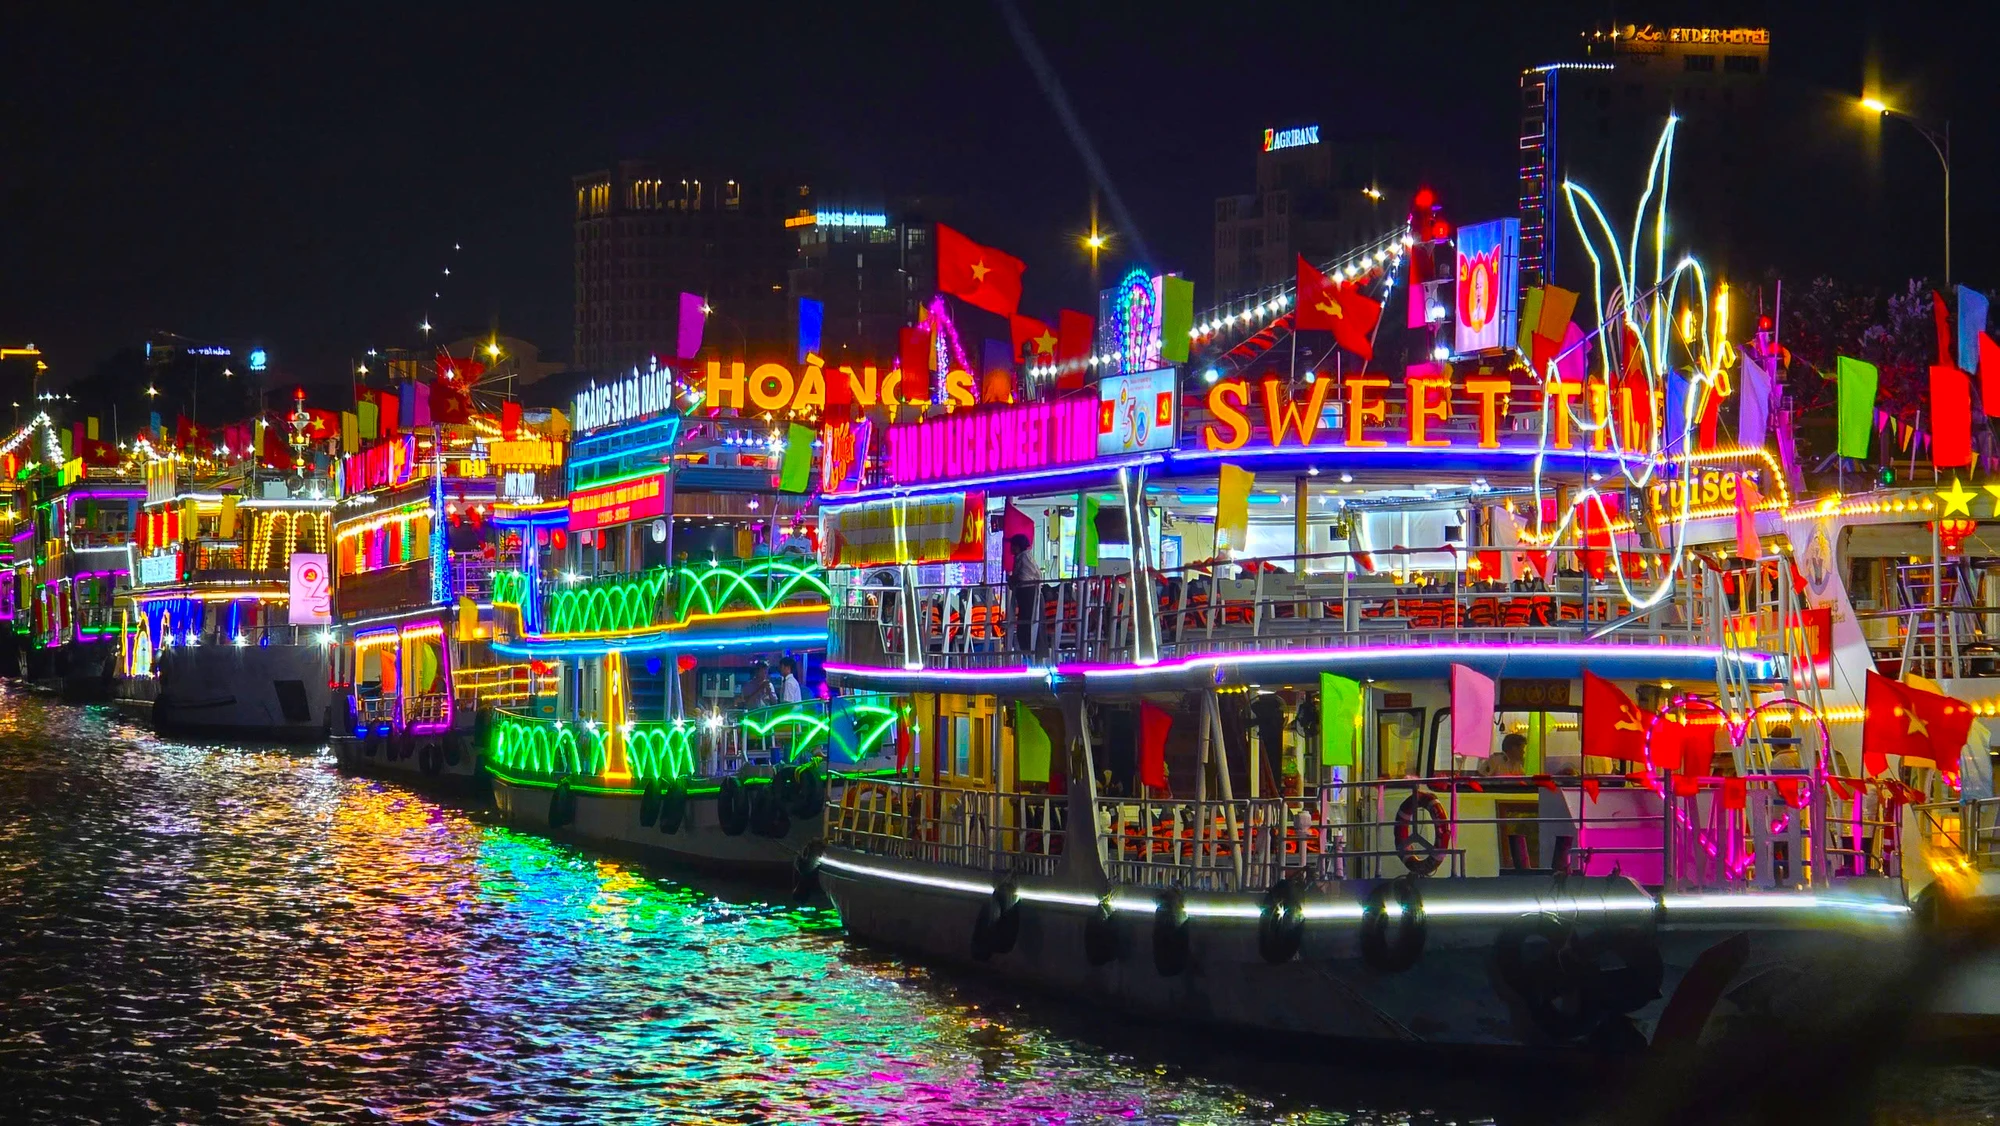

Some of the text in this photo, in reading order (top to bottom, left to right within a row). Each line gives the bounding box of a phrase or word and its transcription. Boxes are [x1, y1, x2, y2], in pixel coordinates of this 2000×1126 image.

[1721, 28, 1768, 43] HOTEL
[1274, 125, 1319, 149] AGRIBANK
[988, 393, 1050, 472] SWEET
[1205, 377, 1511, 450] SWEET
